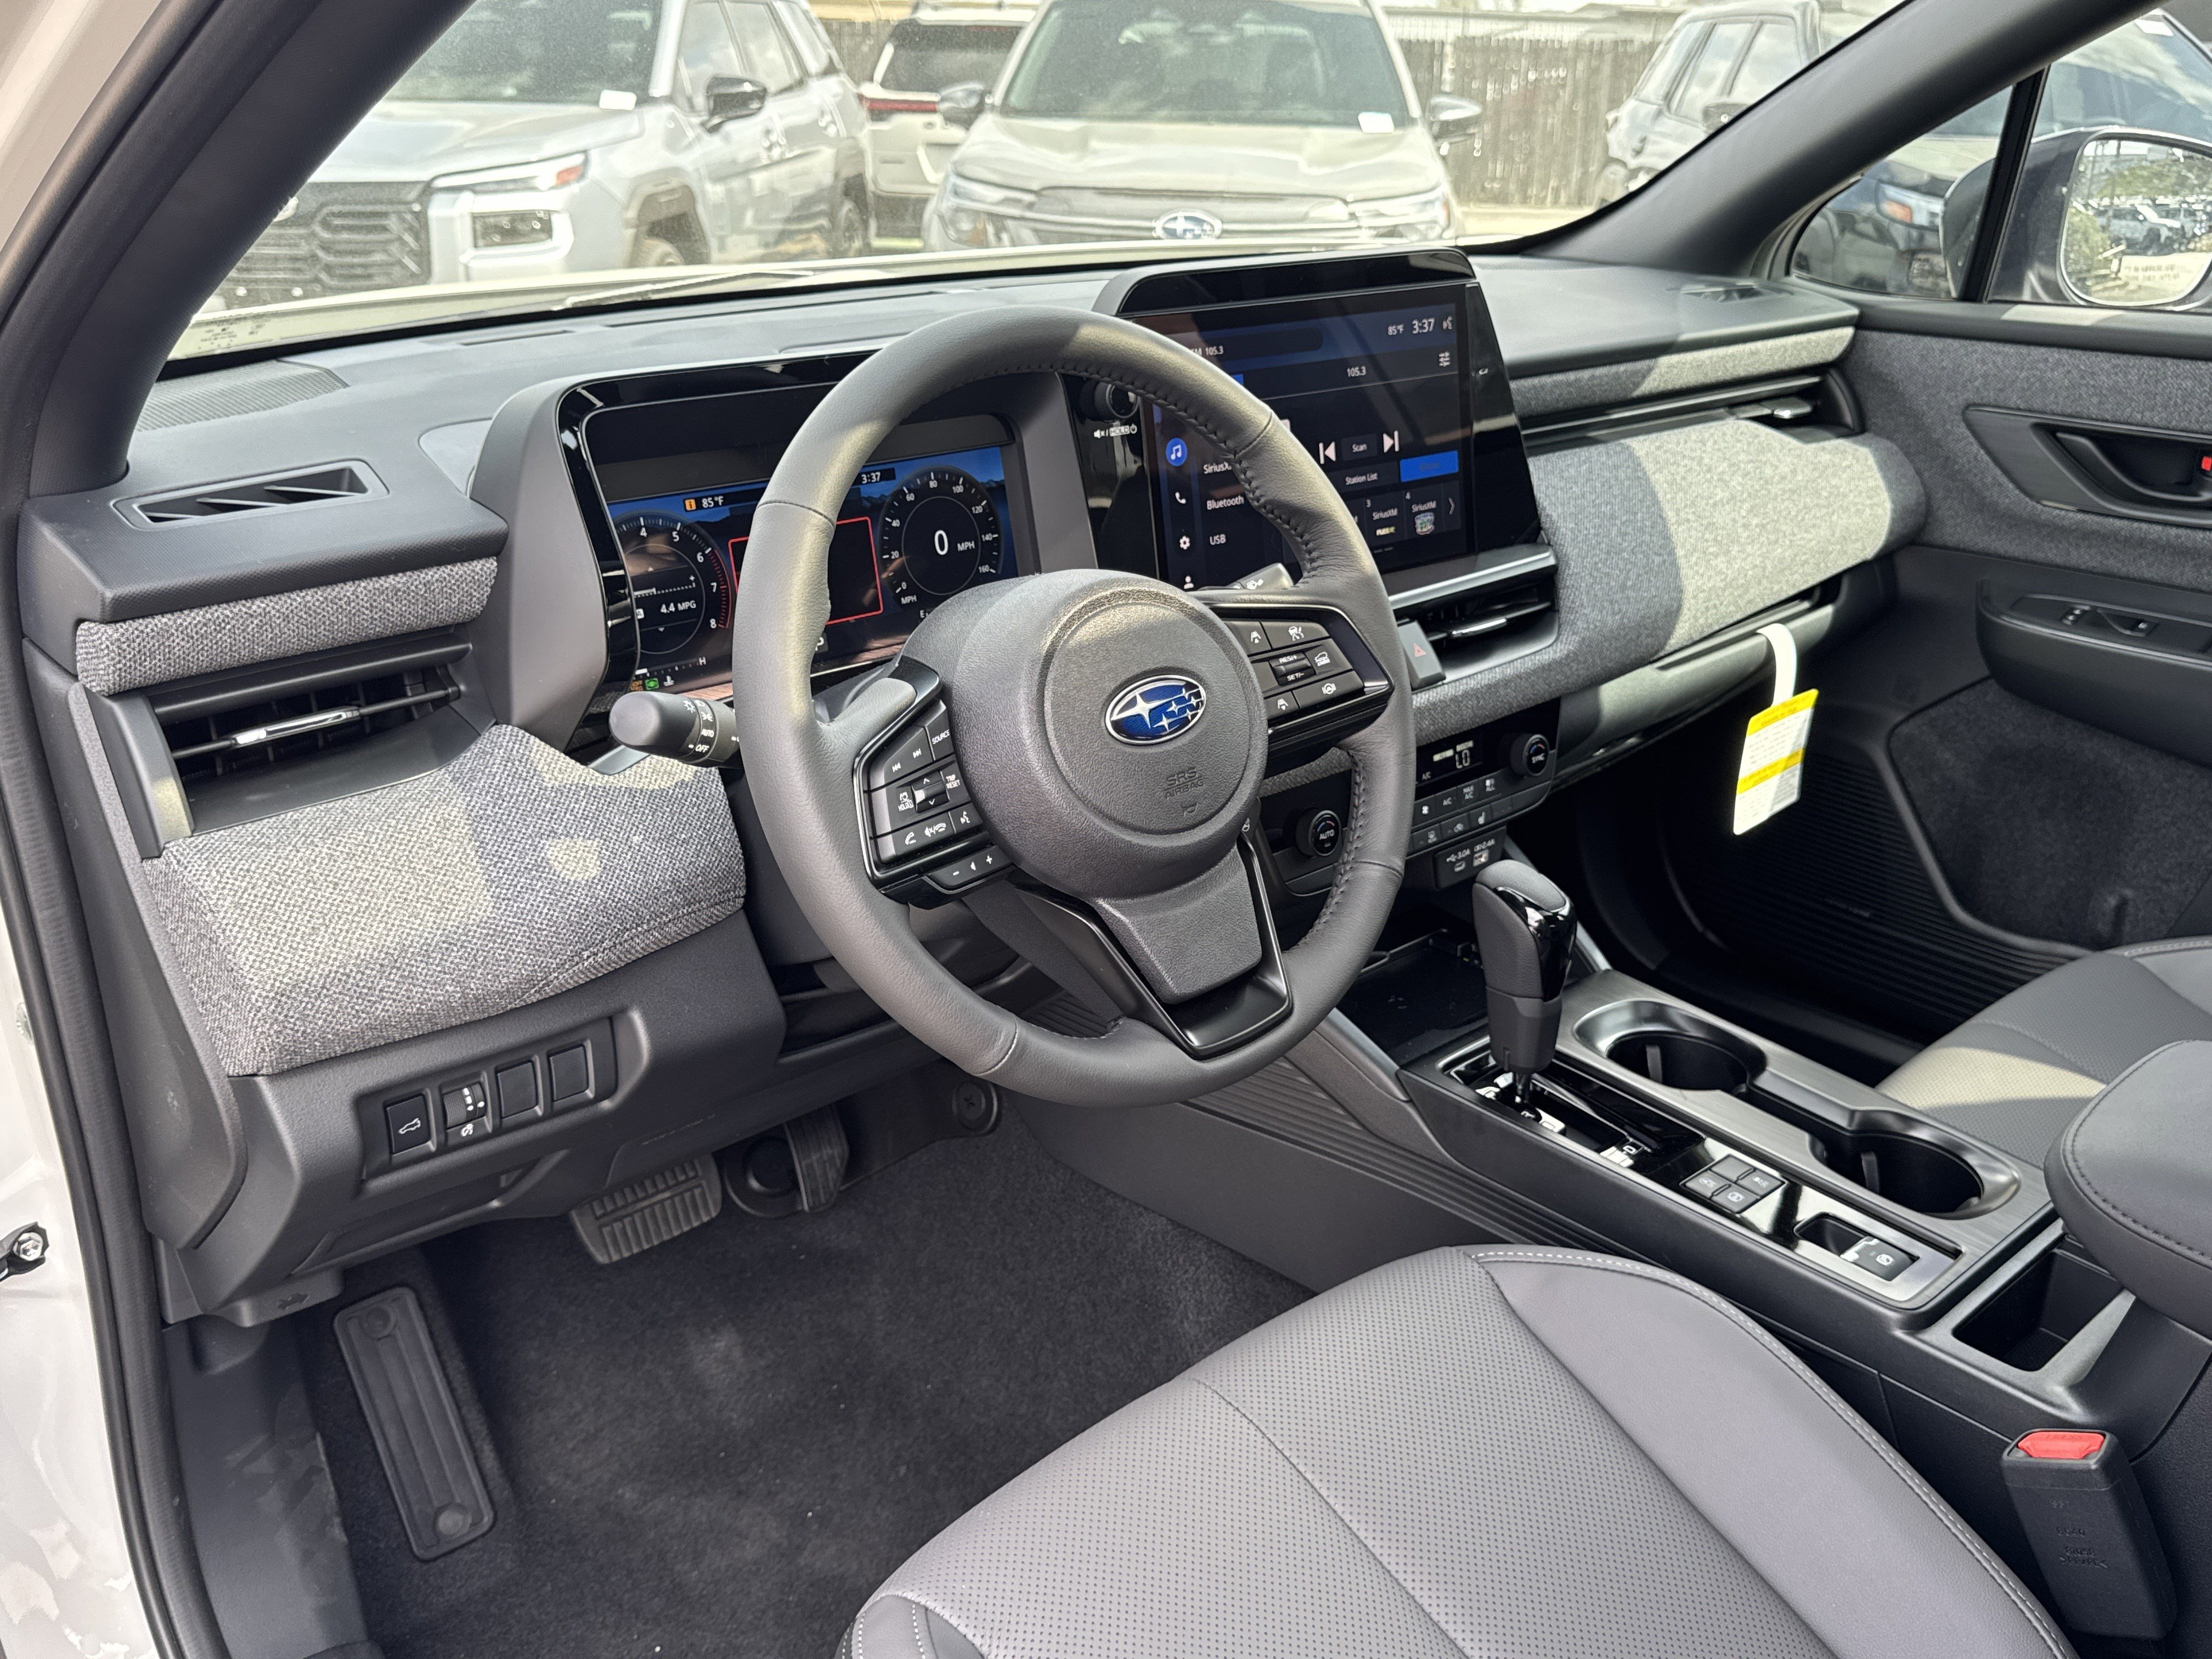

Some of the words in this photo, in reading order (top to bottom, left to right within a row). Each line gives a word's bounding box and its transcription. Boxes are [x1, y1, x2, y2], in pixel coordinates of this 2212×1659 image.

[1412, 318, 1435, 334] 3:37
[1205, 346, 1224, 356] 105.3
[1347, 365, 1367, 377] 105.3
[1352, 443, 1367, 453] Scan
[1203, 461, 1232, 475] SiriusX
[861, 472, 881, 483] 3:37
[1345, 473, 1366, 485] Station
[1367, 472, 1378, 482] List
[929, 480, 938, 488] 80
[952, 485, 964, 493] 100
[702, 496, 724, 508] 85°F
[1207, 495, 1245, 510] Bluetooth
[1366, 499, 1371, 507] 3
[972, 505, 983, 514] 120
[640, 527, 647, 538] 4
[672, 531, 680, 541] 5
[981, 533, 992, 541] 140
[934, 530, 949, 555] 0
[957, 540, 975, 552] MPH
[1209, 534, 1226, 545] USB
[697, 552, 704, 563] 6
[891, 550, 900, 559] 20
[978, 565, 990, 573] 160
[710, 583, 717, 592] 7
[901, 595, 917, 605] MPH
[660, 602, 675, 613] 4.4
[678, 600, 696, 611] MPG
[920, 610, 926, 618] E
[710, 618, 716, 628] 8
[698, 657, 706, 666] H
[701, 729, 714, 738] AUTO
[932, 729, 950, 744] SOURCE
[695, 744, 709, 753] OFF
[946, 774, 956, 782] TRIP
[1166, 768, 1197, 786] SRS
[946, 779, 960, 789] RESET
[1165, 779, 1204, 799] AIRBAG
[1319, 829, 1335, 840] AUTO
